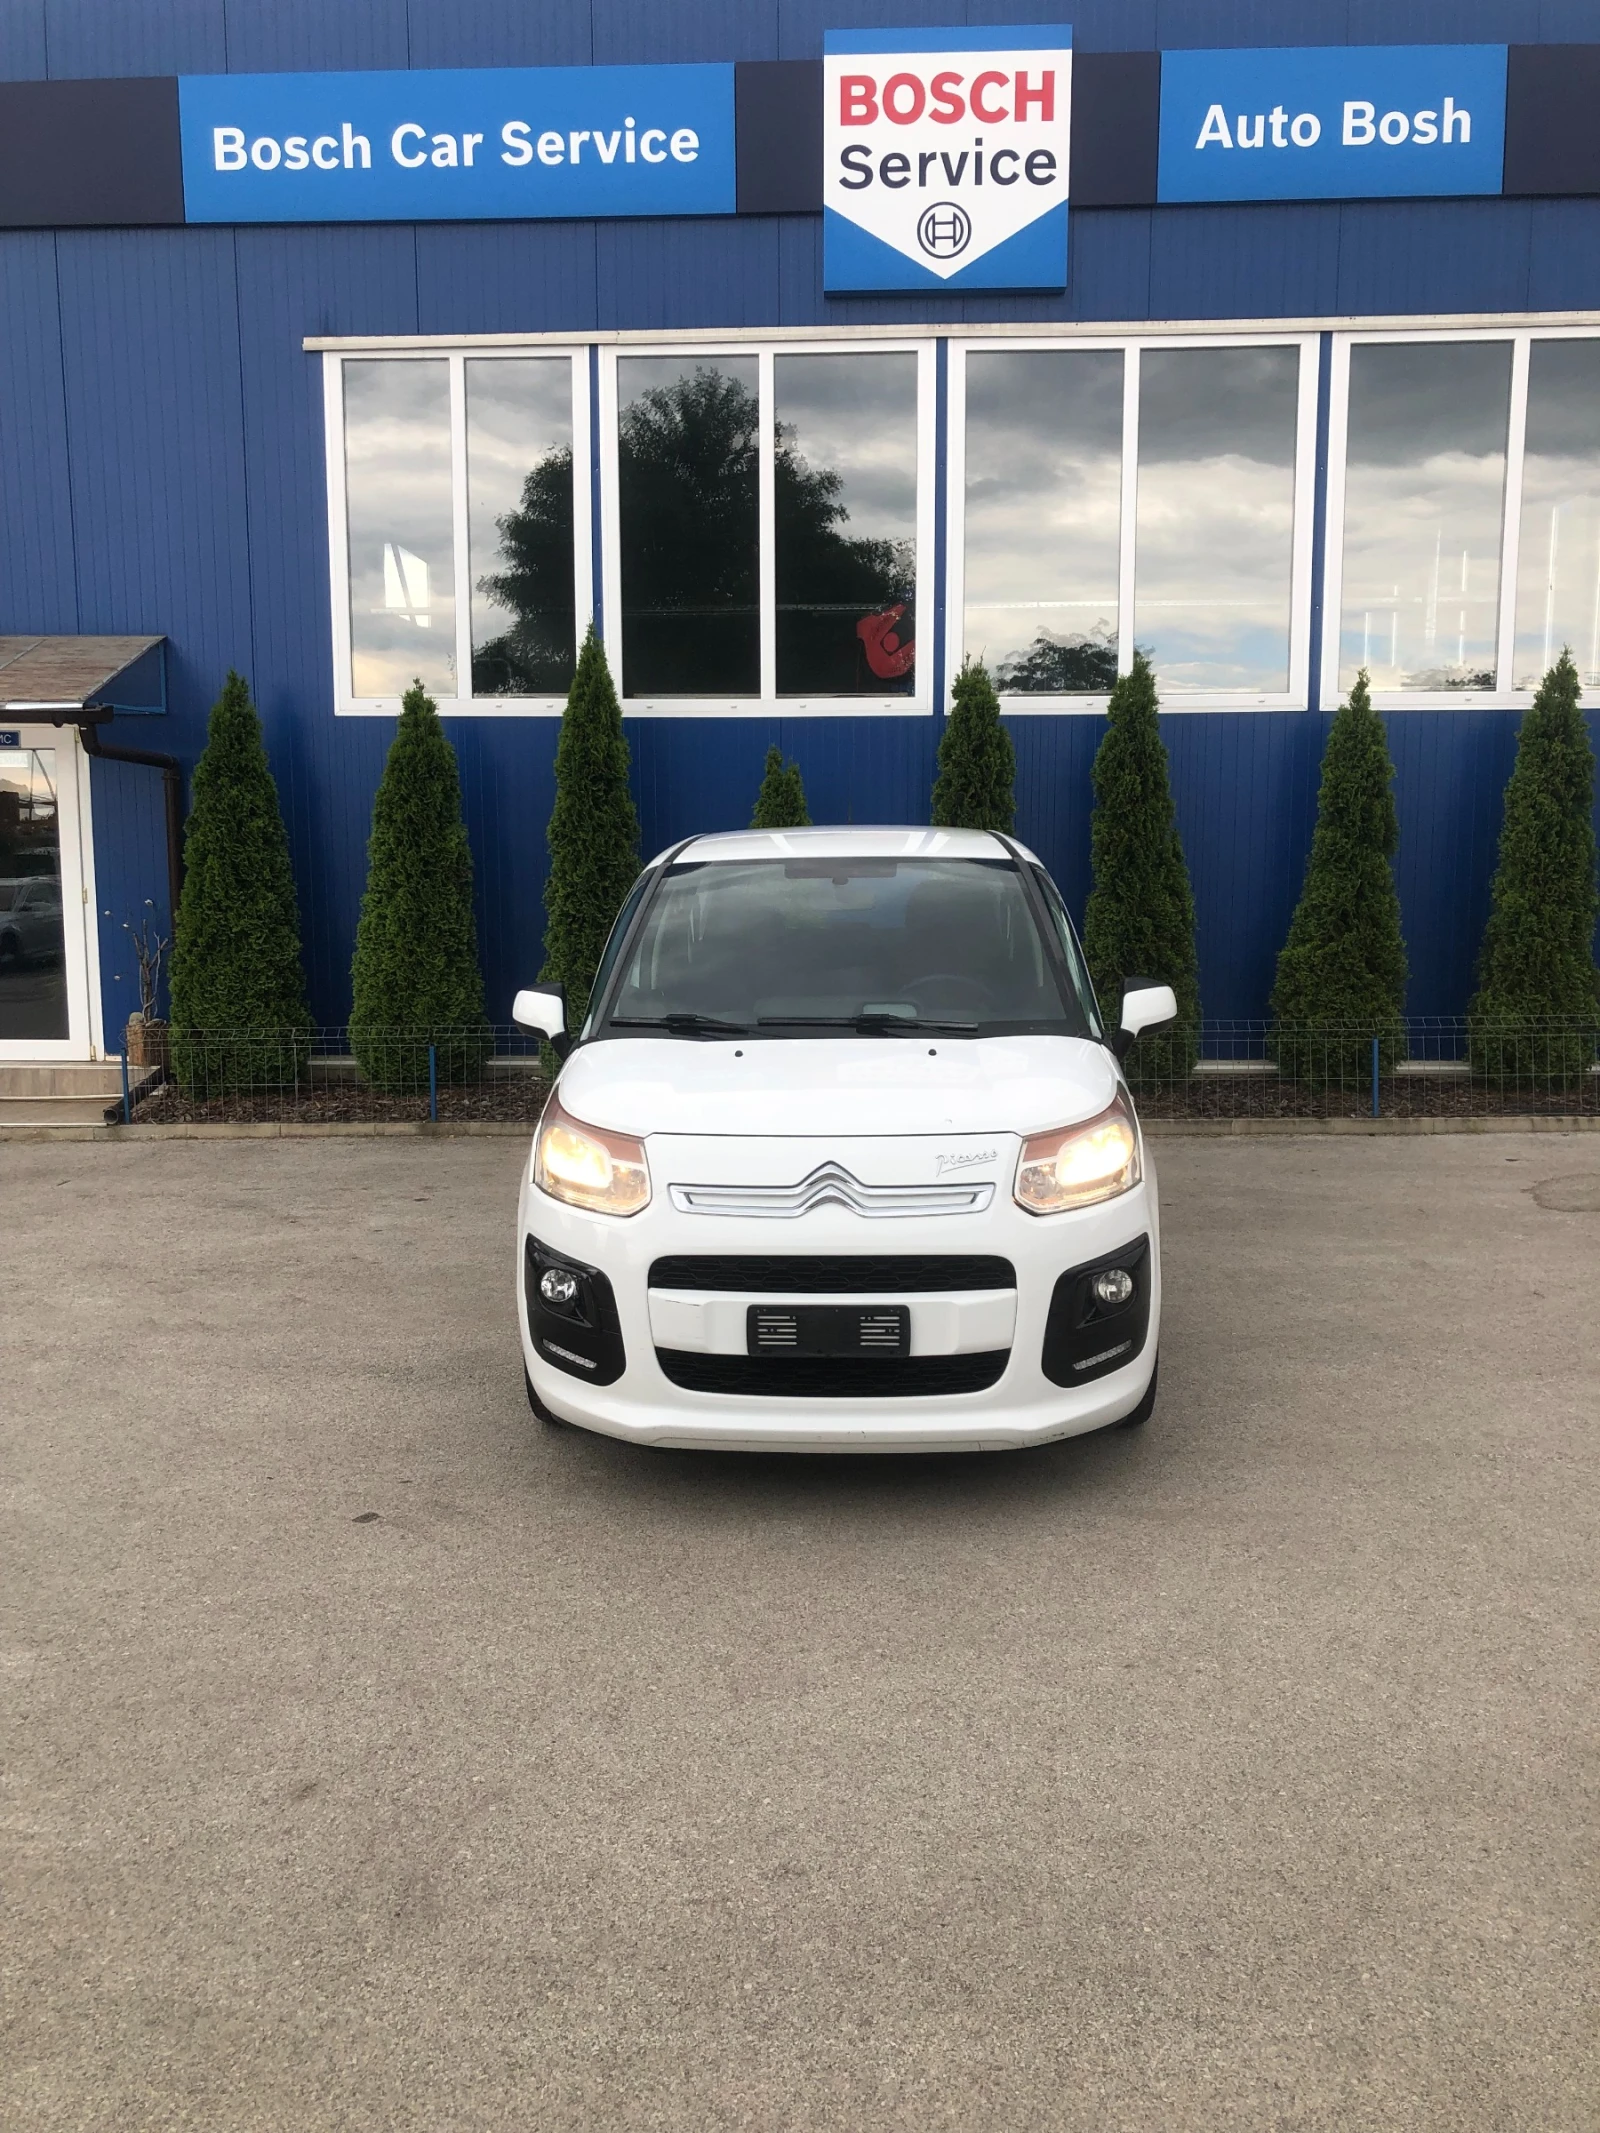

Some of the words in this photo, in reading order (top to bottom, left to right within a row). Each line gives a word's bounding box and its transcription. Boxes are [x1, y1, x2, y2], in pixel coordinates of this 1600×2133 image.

[839, 70, 1055, 127] BOSCH
[1195, 104, 1321, 149] Auto
[1342, 96, 1471, 146] Bosh
[213, 122, 372, 171] Bosch
[391, 122, 484, 168] Car
[500, 117, 700, 166] Service
[838, 137, 1057, 190] Service
